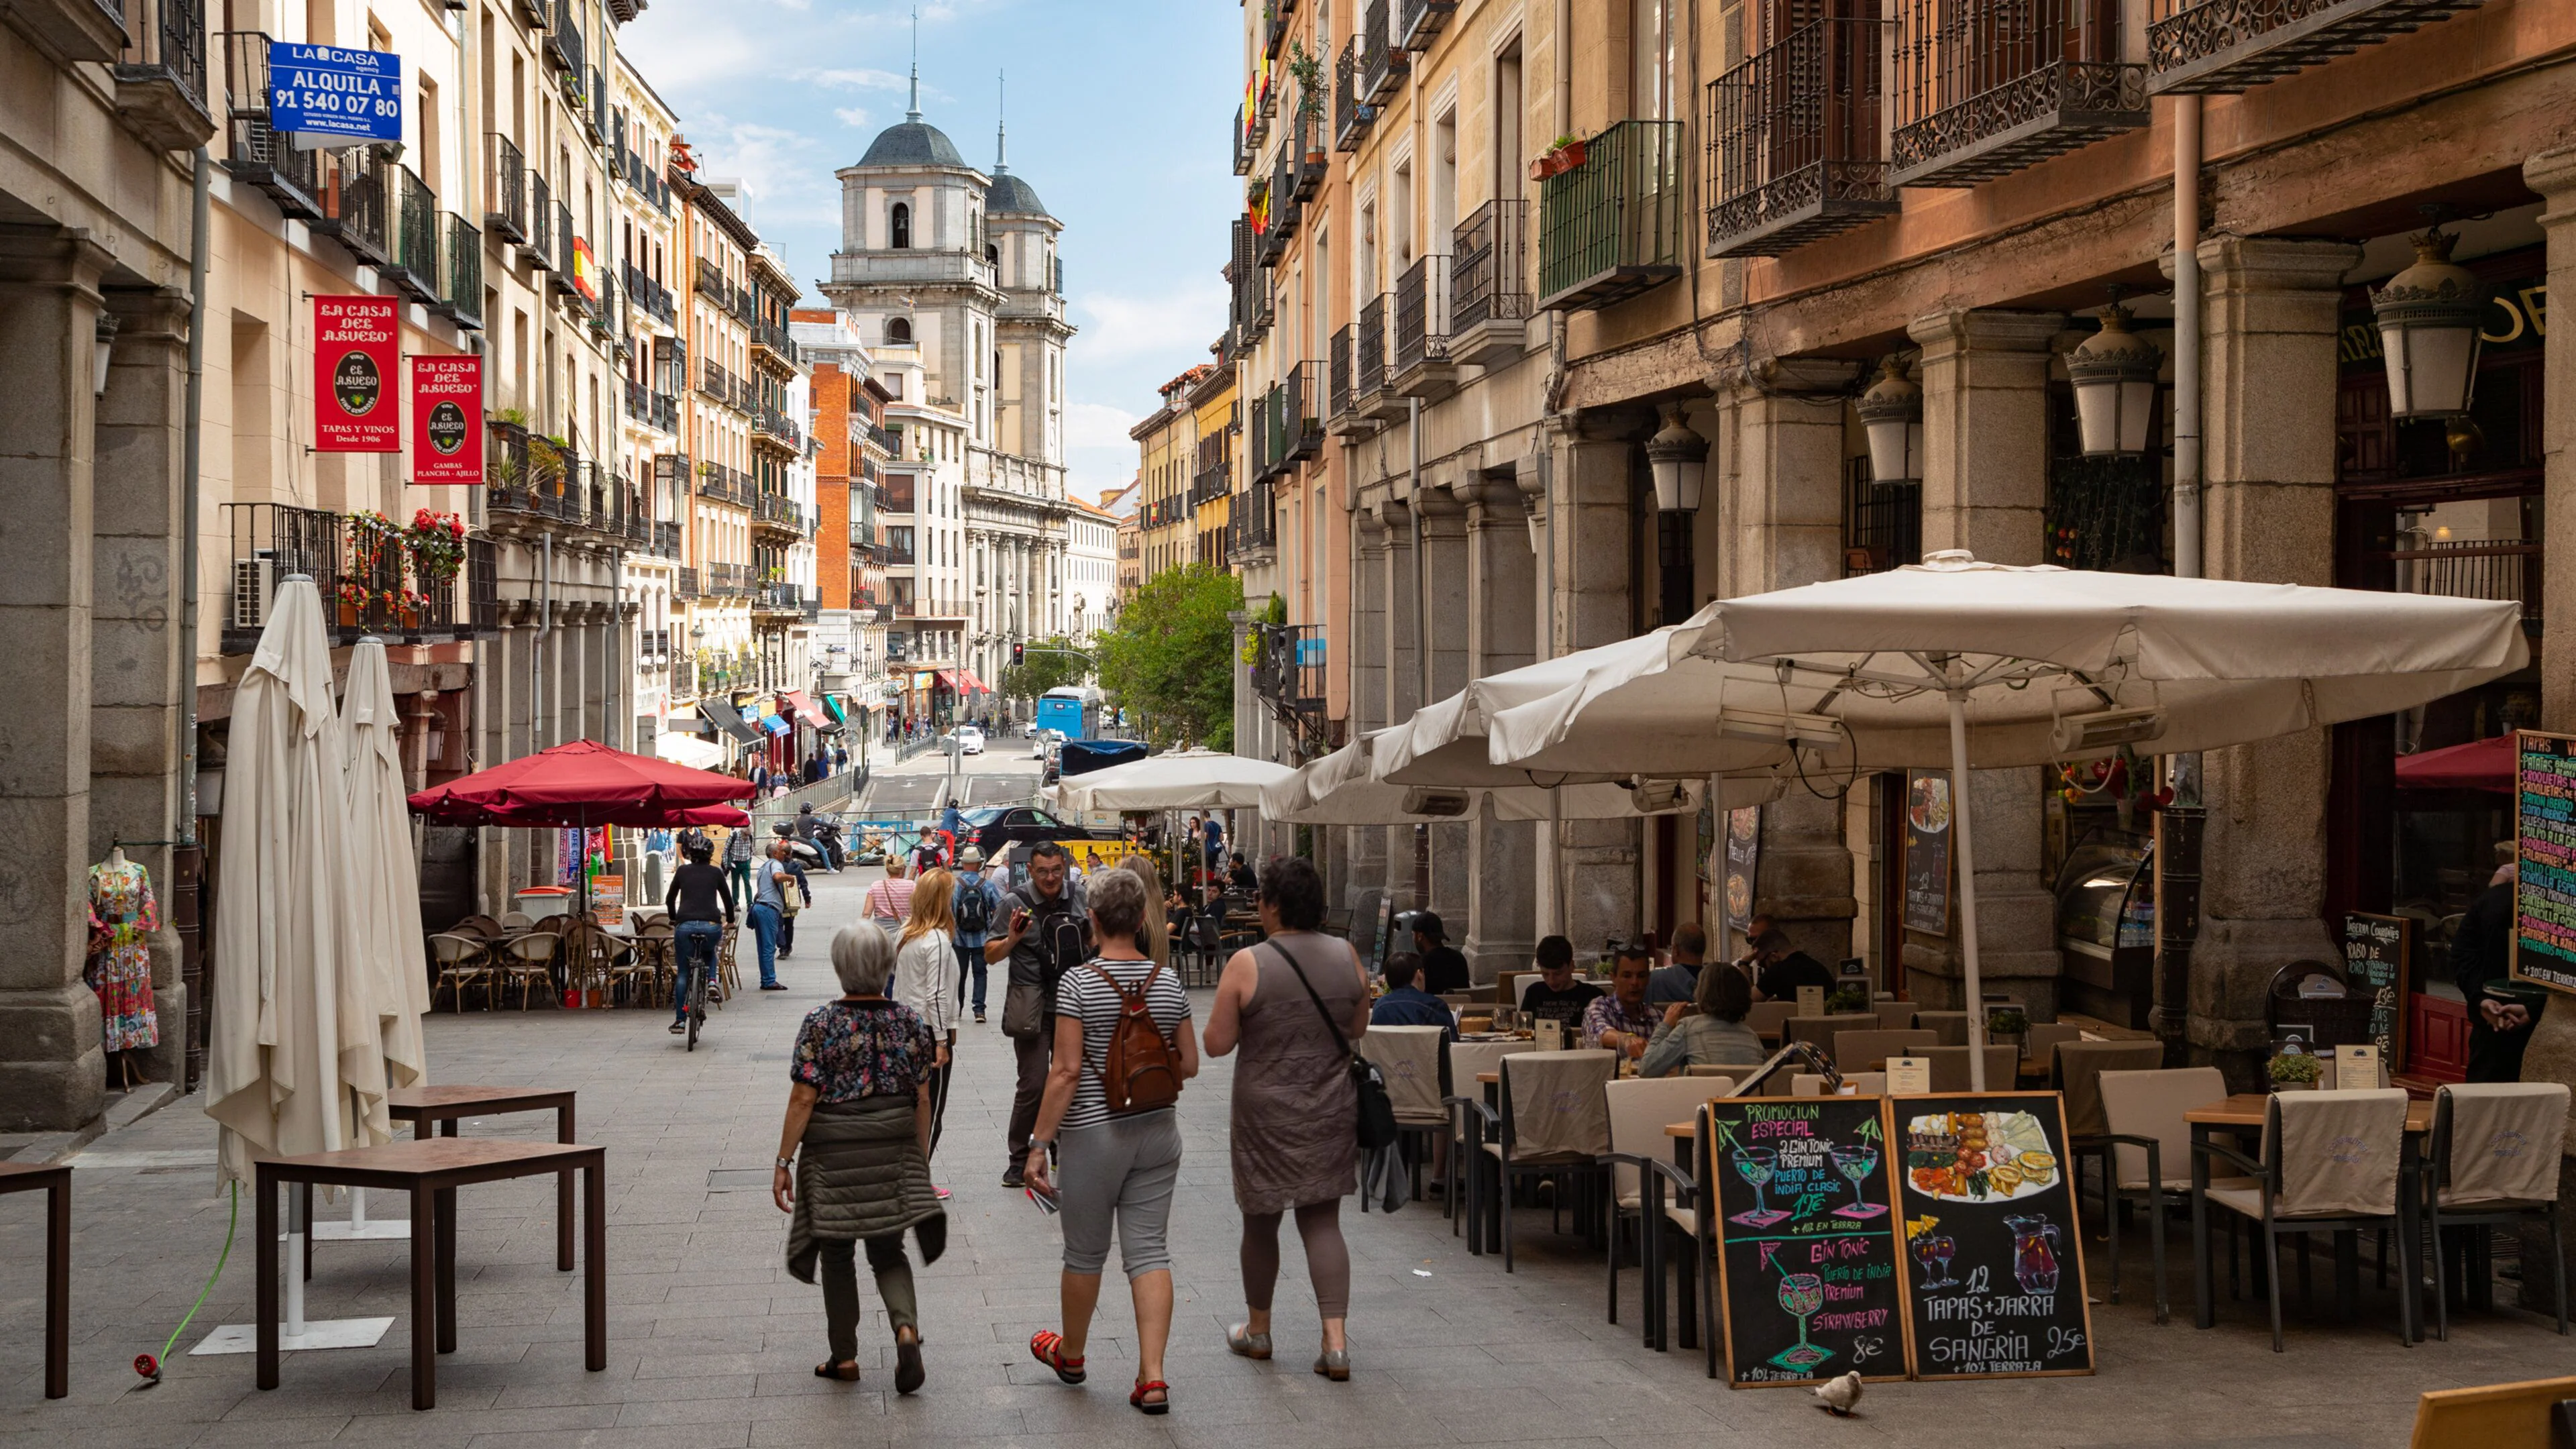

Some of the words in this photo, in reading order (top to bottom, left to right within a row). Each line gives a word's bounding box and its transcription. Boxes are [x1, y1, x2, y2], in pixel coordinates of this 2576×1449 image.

[292, 46, 316, 60] LA
[331, 50, 379, 66] CASA
[356, 66, 379, 74] agency
[292, 71, 381, 95] ALQUILA
[276, 89, 298, 108] 91
[303, 91, 340, 111] 540
[345, 95, 370, 114] 07
[375, 99, 397, 117] 80
[305, 119, 371, 131] www.lacasa.net
[320, 305, 343, 317] LA
[346, 305, 392, 317] CASA
[339, 318, 373, 329] DEL
[350, 365, 363, 376] EL
[417, 363, 435, 372] LA
[438, 362, 476, 372] CASA
[335, 376, 377, 386] ABUELO
[433, 373, 461, 383] DEL
[340, 397, 352, 411] VINO
[351, 396, 376, 414] GENEROSO
[441, 413, 453, 421] EL
[321, 425, 352, 433] TAPAS
[354, 425, 362, 433] Y
[364, 425, 395, 434] VINOS
[430, 421, 464, 430] ABUELO
[336, 435, 359, 443] Desde
[433, 439, 443, 451] VINO
[441, 438, 463, 454] GENEROSO
[2522, 736, 2552, 753] TAPAS
[2522, 754, 2553, 773] PATATAS
[2522, 769, 2568, 788] CROQUETAS
[2522, 780, 2564, 798] CROQUETAS
[2522, 814, 2546, 828] QUESO
[2522, 824, 2546, 840] PULPO
[2522, 870, 2554, 890] TORTILLA
[604, 885, 623, 894] TOLEDO
[2521, 882, 2546, 898] QUESO
[2347, 941, 2367, 959] RABO
[2369, 945, 2380, 960] DE
[2347, 960, 2365, 975] TORO
[2379, 1022, 2389, 1034] DE
[1752, 1120, 1815, 1140] ESPECIAL
[1779, 1153, 1823, 1169] PREMIUM
[1774, 1168, 1807, 1185] PUERTO
[1812, 1168, 1825, 1181] DE
[1807, 1179, 1841, 1192] CLASIC
[1816, 1220, 1829, 1232] EN
[1830, 1219, 1862, 1230] TERRAZA
[1811, 1239, 1835, 1264] GIN
[1838, 1237, 1870, 1260] TONIC
[1852, 1267, 1865, 1280] DE
[1966, 1265, 1990, 1294] 12
[1823, 1283, 1864, 1301] PREMIUM
[1923, 1295, 1983, 1322] TAPAS
[1994, 1295, 2055, 1317] JARRA
[1811, 1308, 1889, 1332] STRAWBERRY
[1971, 1320, 1997, 1338] DE
[1929, 1329, 2029, 1362] SANGRIA
[1989, 1360, 2043, 1373] TERRAZA
[1768, 1370, 1815, 1381] TERRAZA
